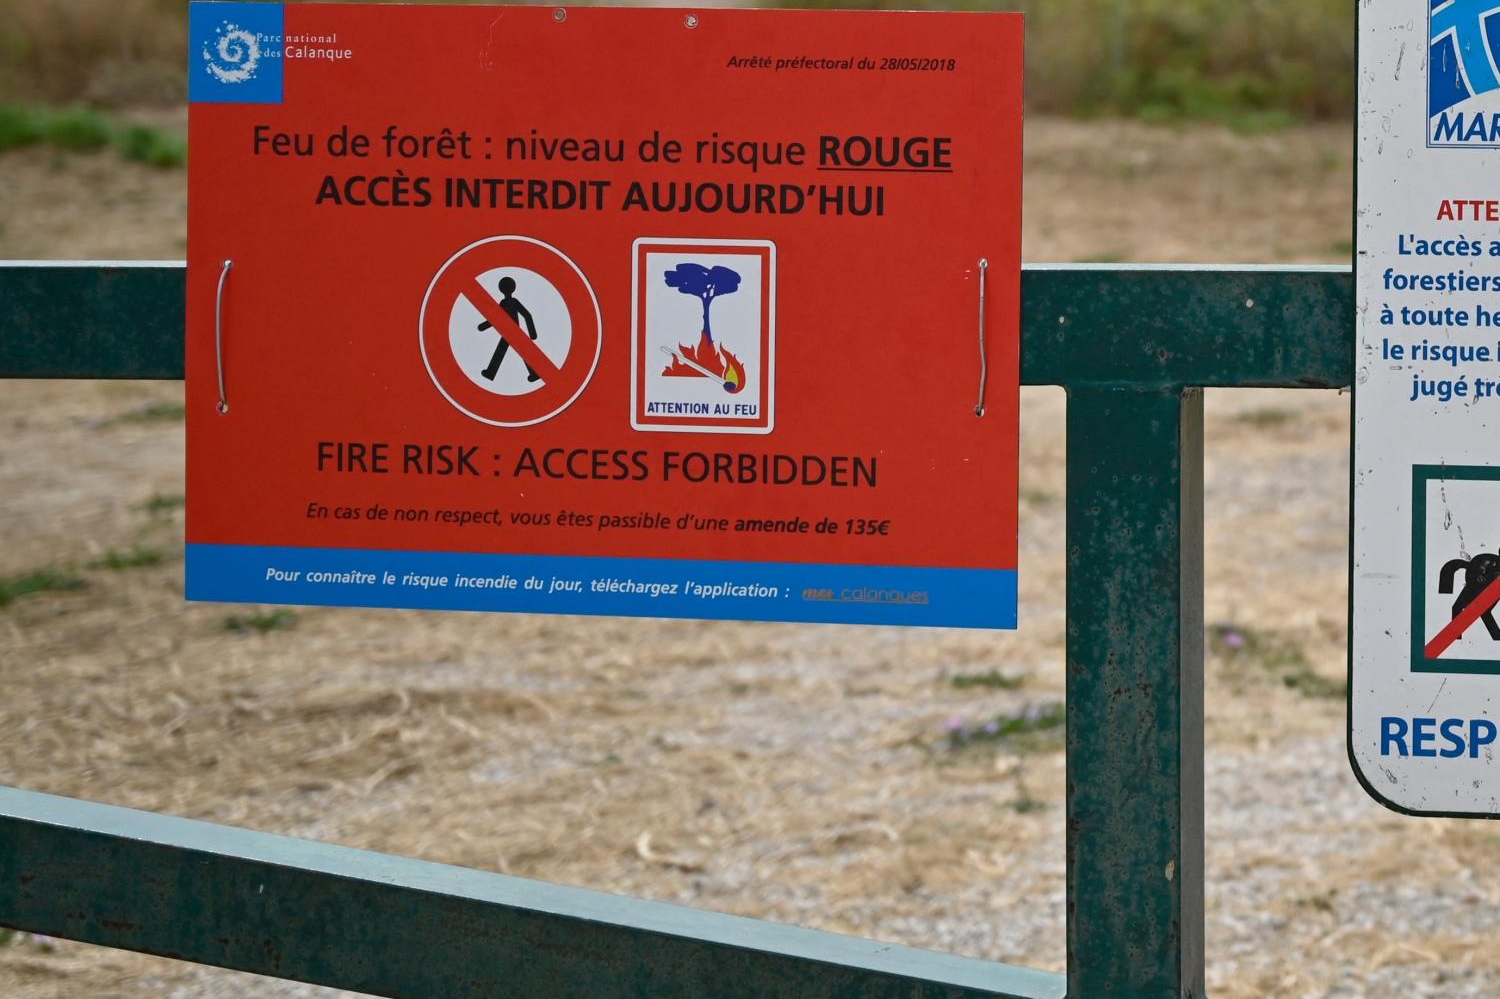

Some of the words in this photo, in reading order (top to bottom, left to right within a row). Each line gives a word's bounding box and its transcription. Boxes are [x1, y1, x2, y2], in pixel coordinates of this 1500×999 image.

[256, 32, 281, 42] Parc
[285, 33, 337, 43] national
[263, 48, 281, 57] des
[285, 46, 352, 62] Calanque
[726, 54, 772, 69] Arrêté
[775, 56, 853, 71] préfectoral
[857, 57, 876, 70] du
[879, 57, 956, 72] 28/05/2018
[253, 125, 314, 157] Feu
[327, 125, 369, 157] de
[383, 126, 472, 159] forêt
[506, 129, 624, 162] niveau
[638, 131, 682, 164] de
[696, 132, 805, 172] risque
[818, 135, 953, 169] ROUGE
[315, 170, 432, 208] ACCÈS
[445, 178, 611, 211] INTERDIT
[622, 181, 885, 216] AUJOURD'HUI
[1398, 233, 1482, 257] L'accès
[1380, 303, 1394, 326] à
[1400, 307, 1469, 327] toute
[1382, 339, 1404, 360] le
[1411, 340, 1490, 368] risque
[1409, 376, 1468, 402] jugé
[647, 401, 709, 415] ATTENTION
[714, 403, 730, 415] AU
[735, 404, 757, 416] FEU
[317, 441, 388, 474] FIRE
[403, 444, 480, 476] RISK
[513, 447, 649, 481] ACCESS
[663, 451, 878, 488] FORBIDDEN
[306, 502, 329, 519] En
[334, 505, 361, 520] cas
[365, 503, 389, 521] de
[394, 508, 429, 522] non
[434, 508, 503, 527] respect,
[510, 511, 551, 526] vous
[556, 509, 593, 527] êtes
[598, 512, 670, 530] passible
[676, 512, 728, 532] d'une
[734, 516, 810, 534] amende
[815, 518, 838, 535] de
[845, 519, 891, 536] 135€
[265, 567, 301, 583] Pour
[306, 568, 376, 585] connaître
[382, 571, 397, 585] le
[402, 571, 448, 589] risque
[454, 573, 517, 590] incendie
[524, 574, 544, 591] du
[548, 576, 583, 594] jour,
[591, 577, 678, 595] téléchargez
[685, 580, 778, 599] l'application
